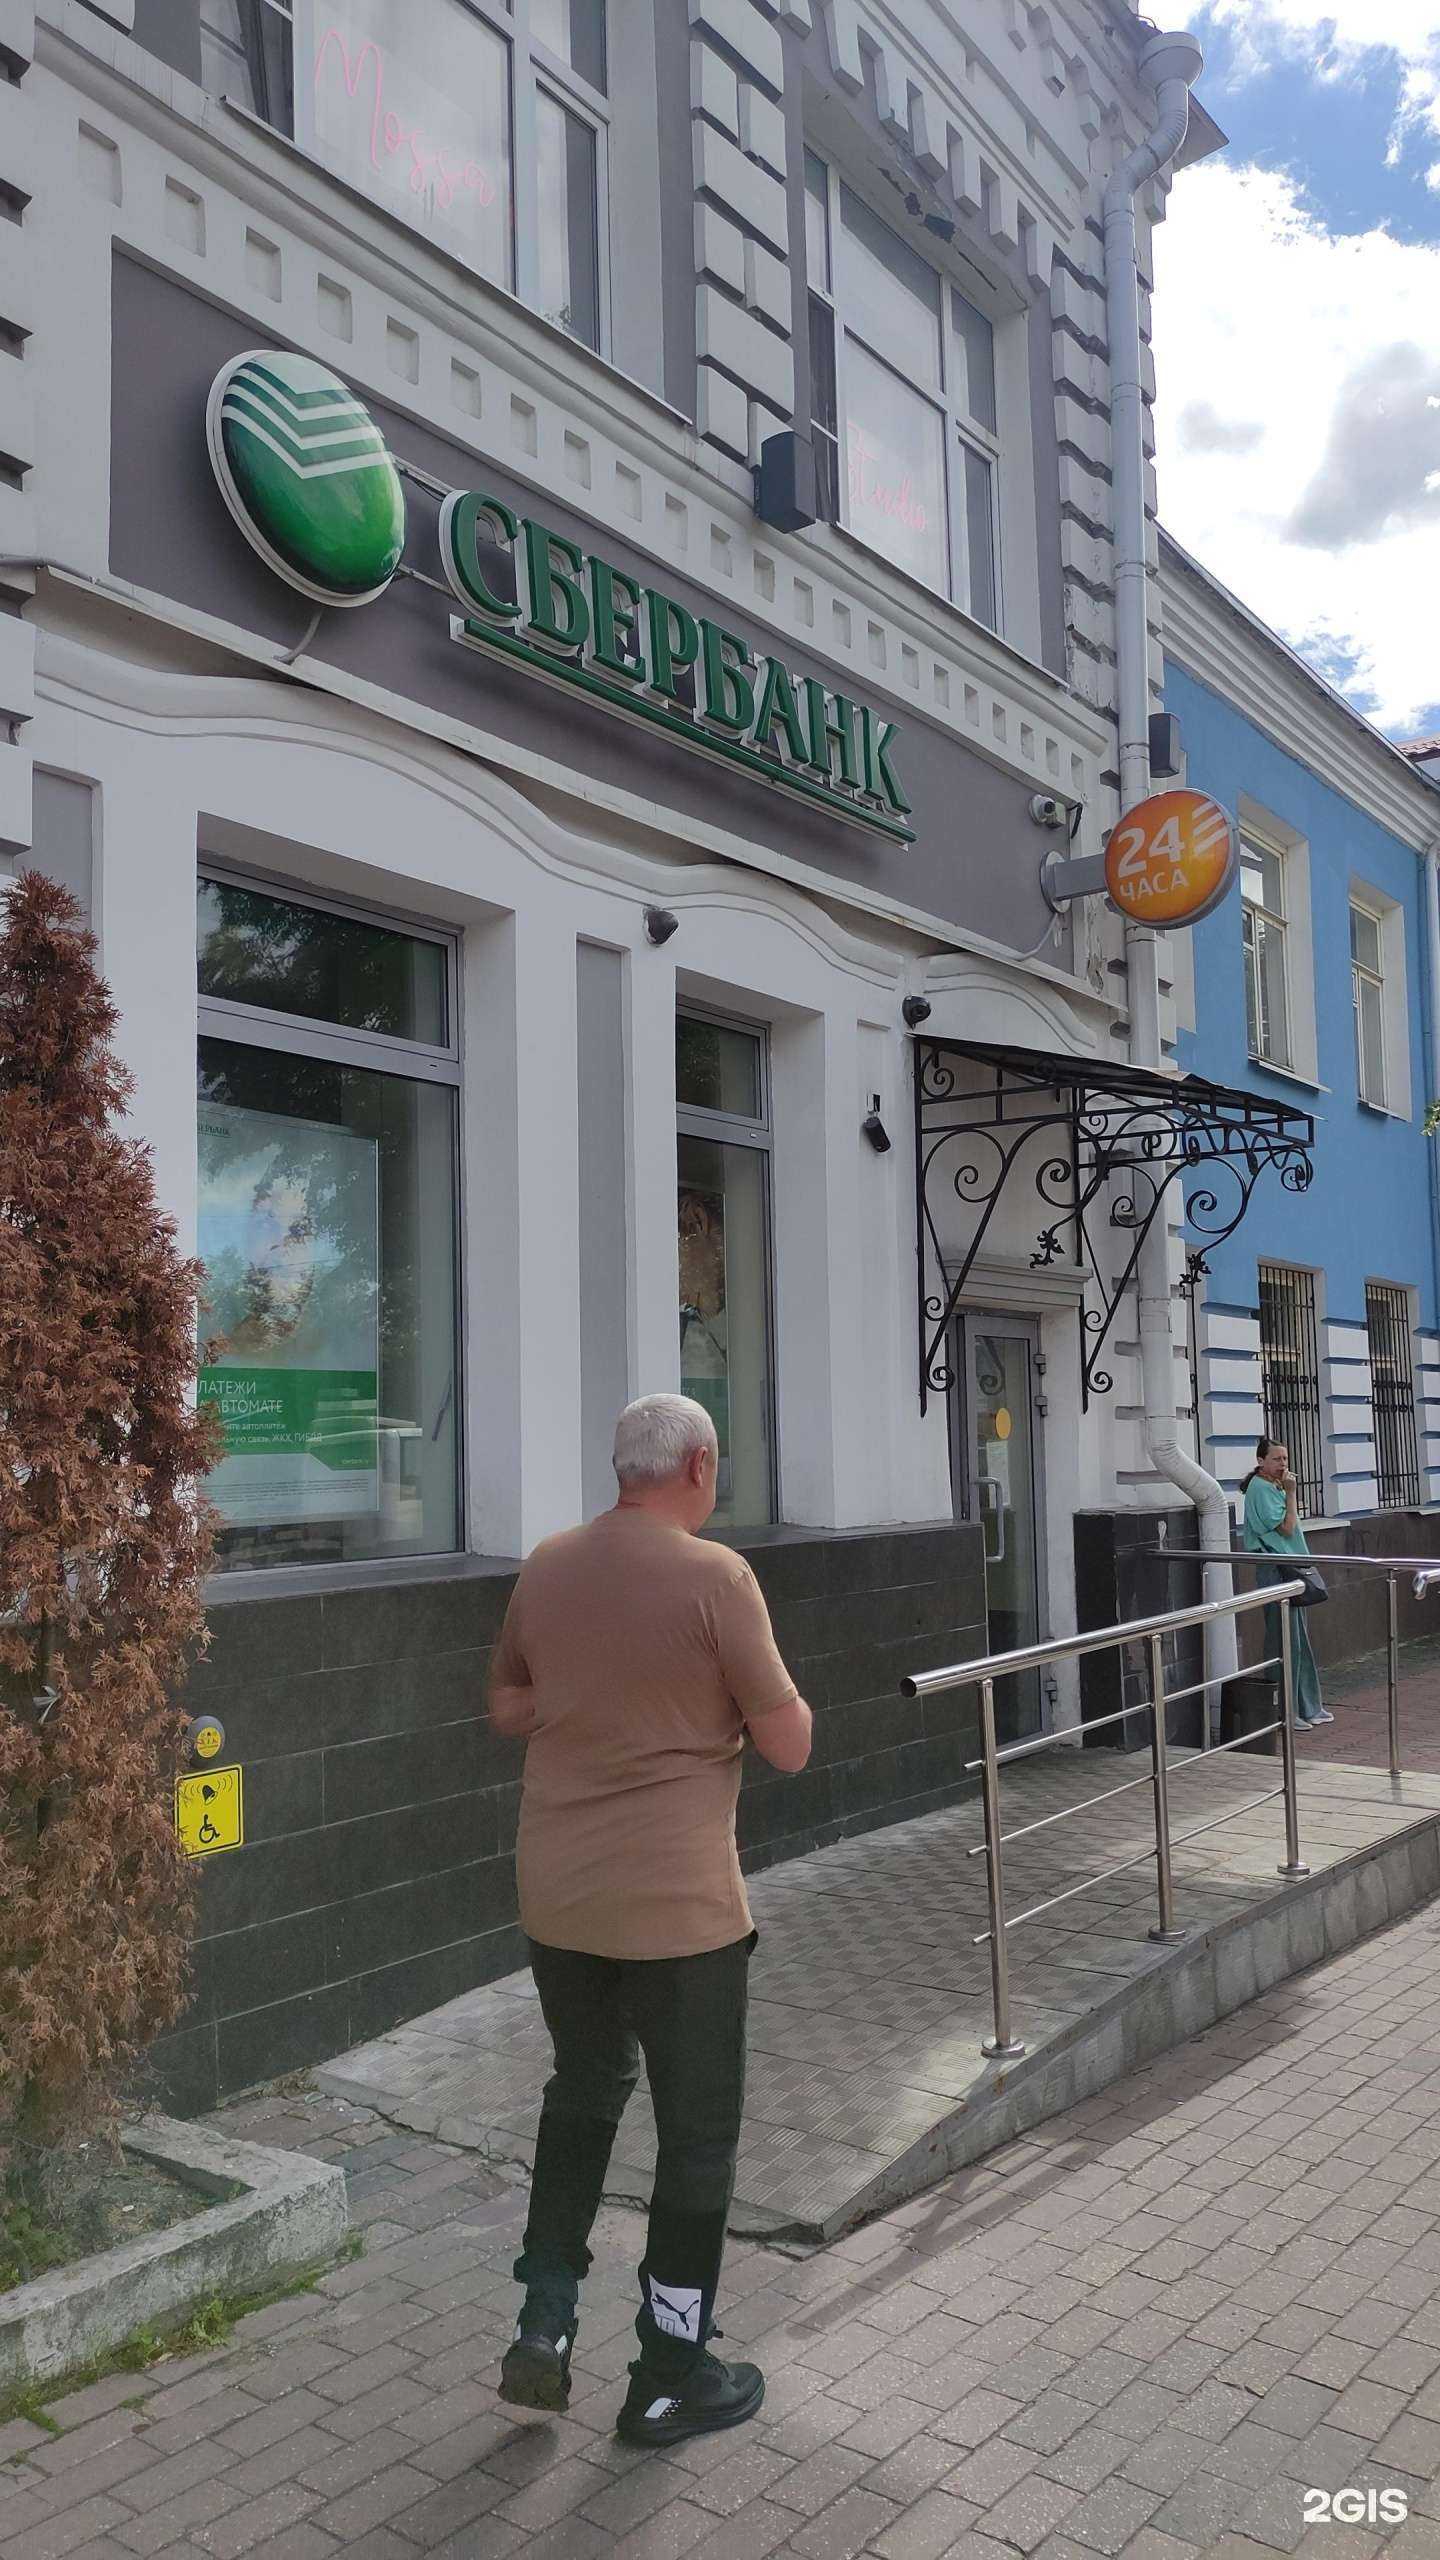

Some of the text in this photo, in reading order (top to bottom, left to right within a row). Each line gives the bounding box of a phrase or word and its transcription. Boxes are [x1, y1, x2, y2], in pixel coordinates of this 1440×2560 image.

[439, 489, 913, 817] СБЕРБАНК
[1117, 815, 1185, 879] 24
[1119, 868, 1190, 901] ЧАСА
[198, 1380, 256, 1394] ЛАТЕЖИ
[218, 1400, 284, 1414] ВТОМАТЕ
